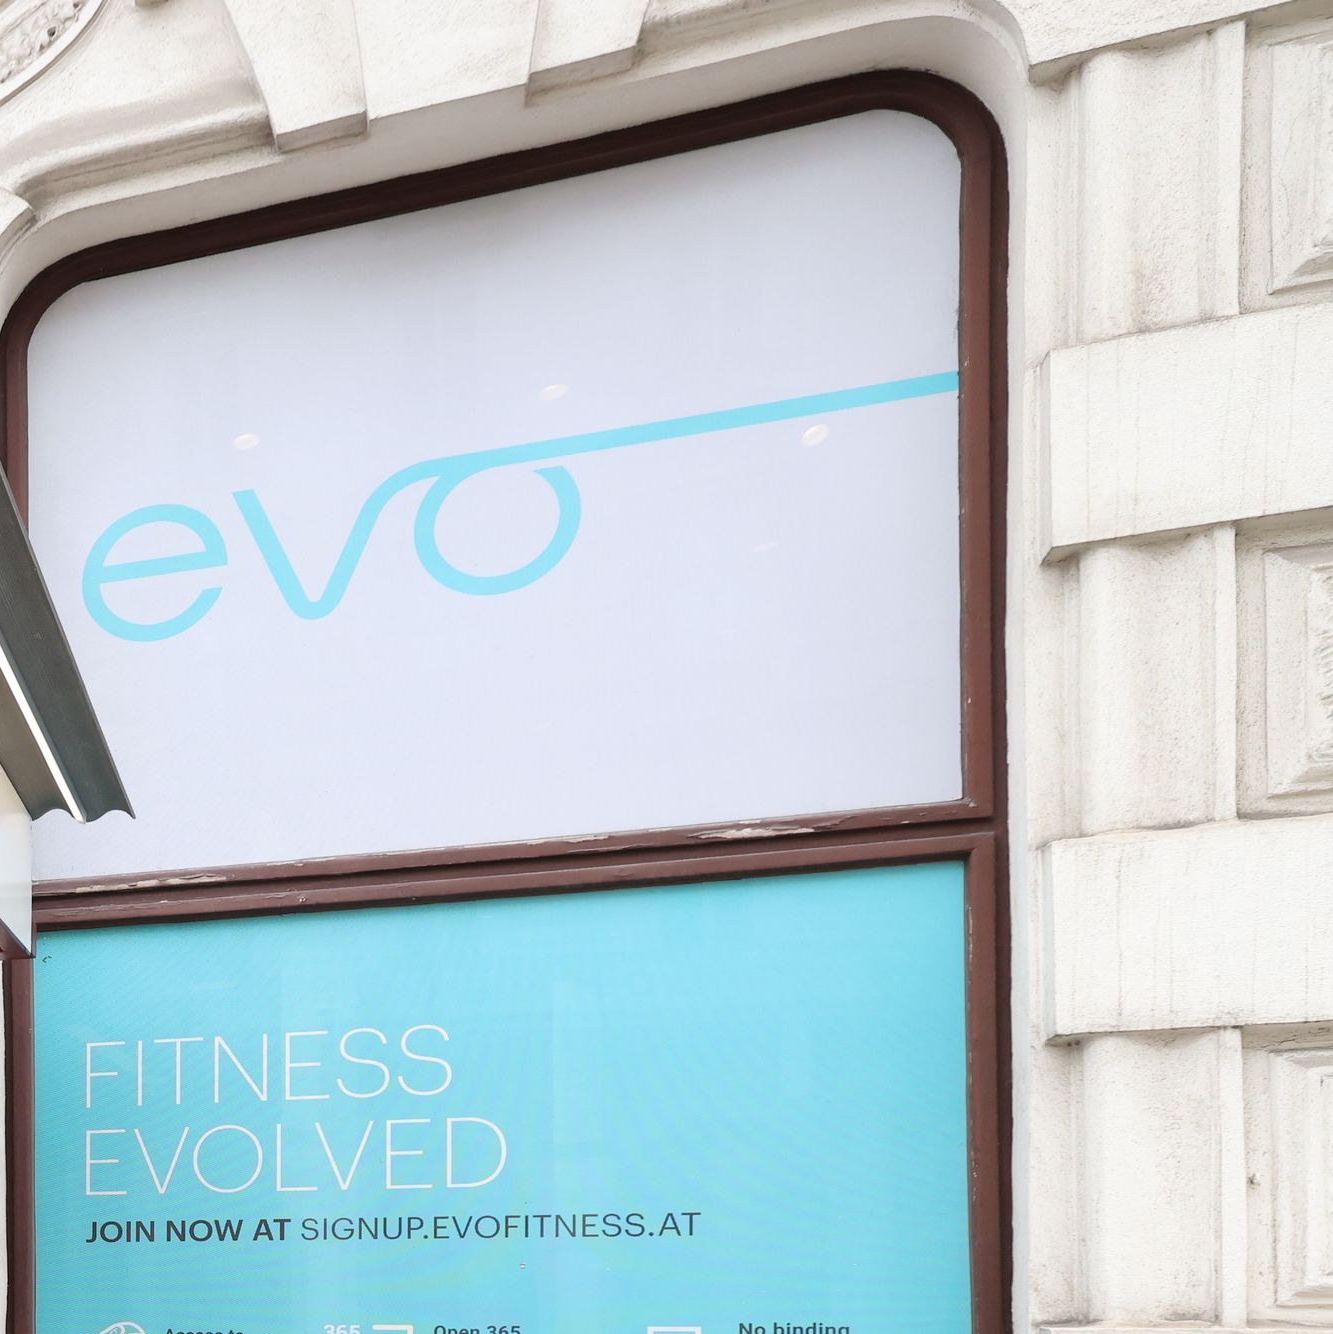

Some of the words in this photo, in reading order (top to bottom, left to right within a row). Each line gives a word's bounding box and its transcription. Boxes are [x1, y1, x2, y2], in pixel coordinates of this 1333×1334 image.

[84, 1023, 454, 1109] FITNESS
[83, 1115, 509, 1197] EVOLVED
[85, 1220, 155, 1244] JOIN
[165, 1219, 244, 1243] NOW
[252, 1218, 292, 1242] AT
[300, 1212, 702, 1242] SIGNUP.EVOFITNESS.AT
